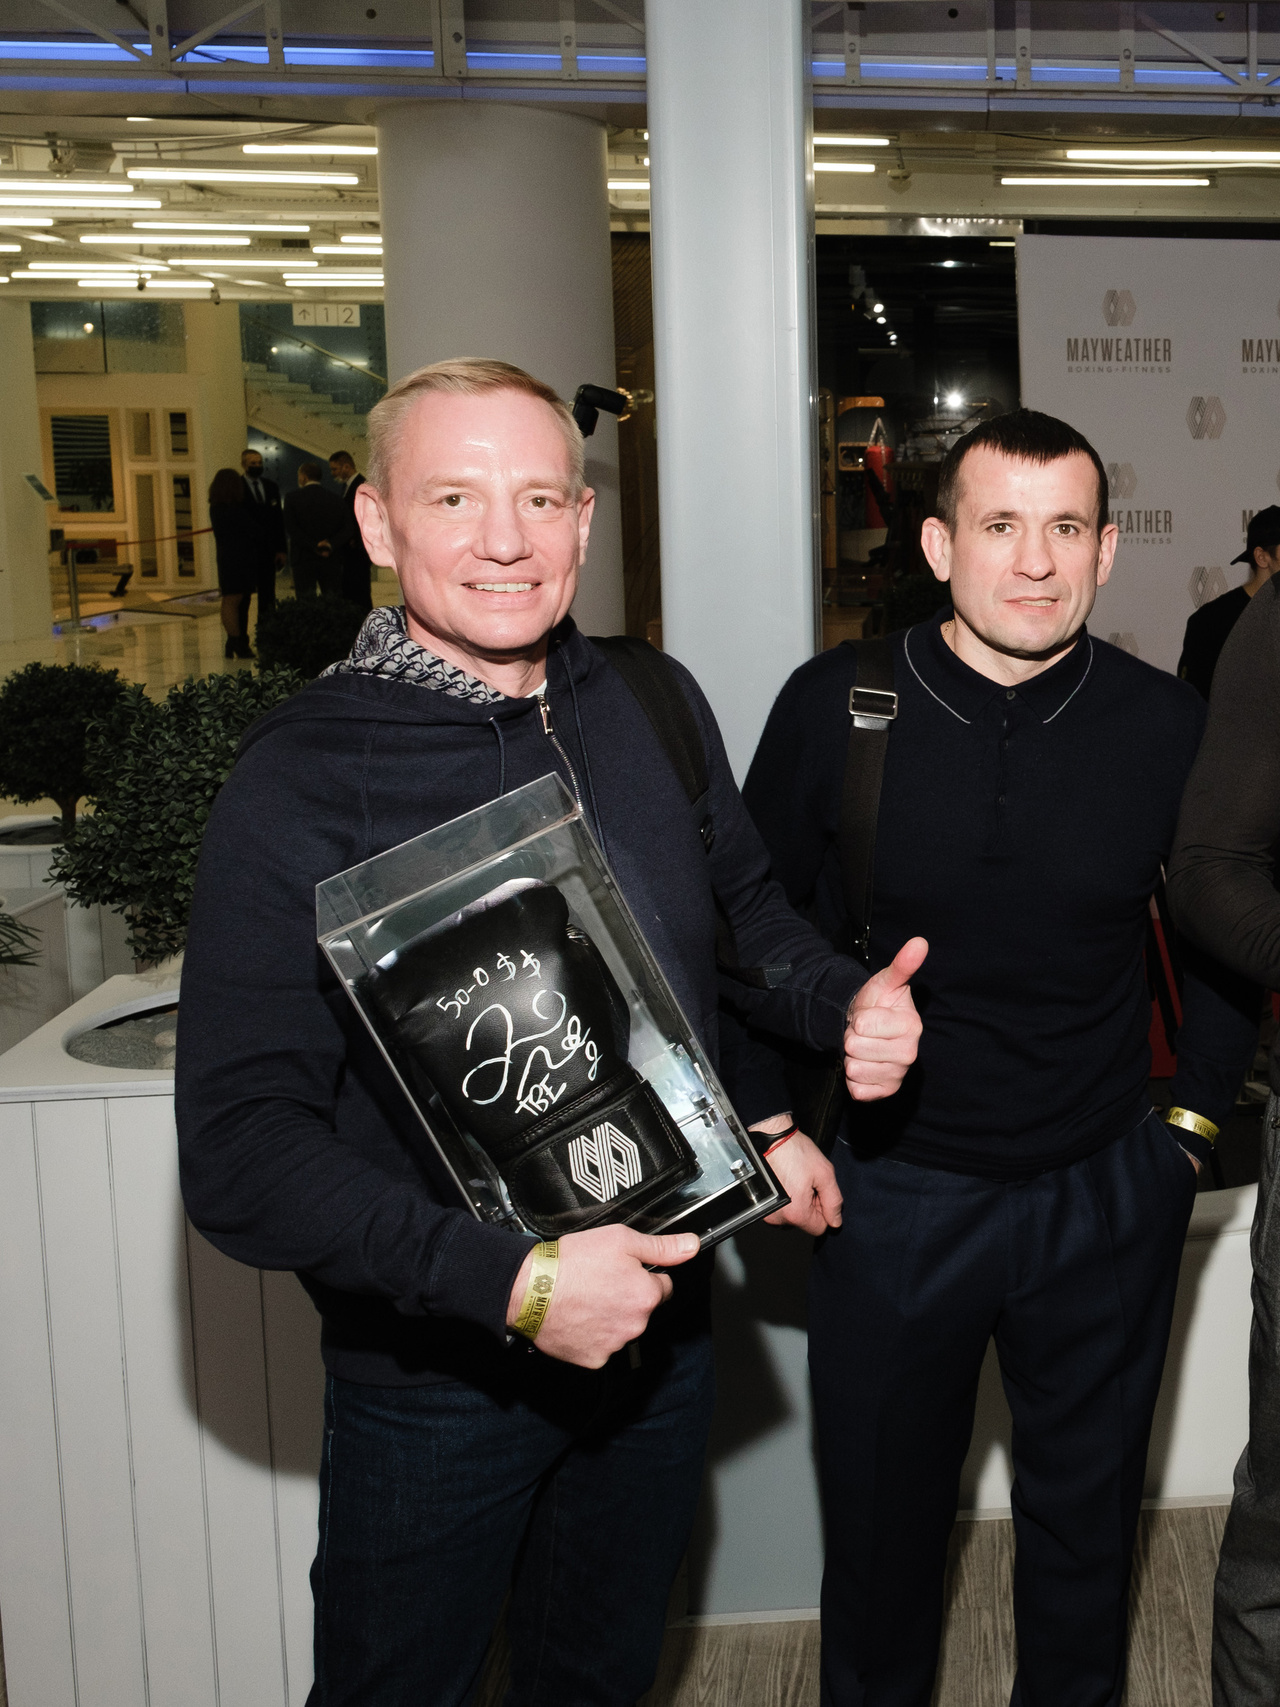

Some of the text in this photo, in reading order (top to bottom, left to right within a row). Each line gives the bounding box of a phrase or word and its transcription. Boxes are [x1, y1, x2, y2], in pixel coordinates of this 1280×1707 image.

[343, 307, 354, 324] 2
[1066, 338, 1172, 361] MAYWEATHER
[1109, 510, 1172, 533] EATHER
[437, 967, 490, 1019] 50-0
[515, 1073, 567, 1116] TBE
